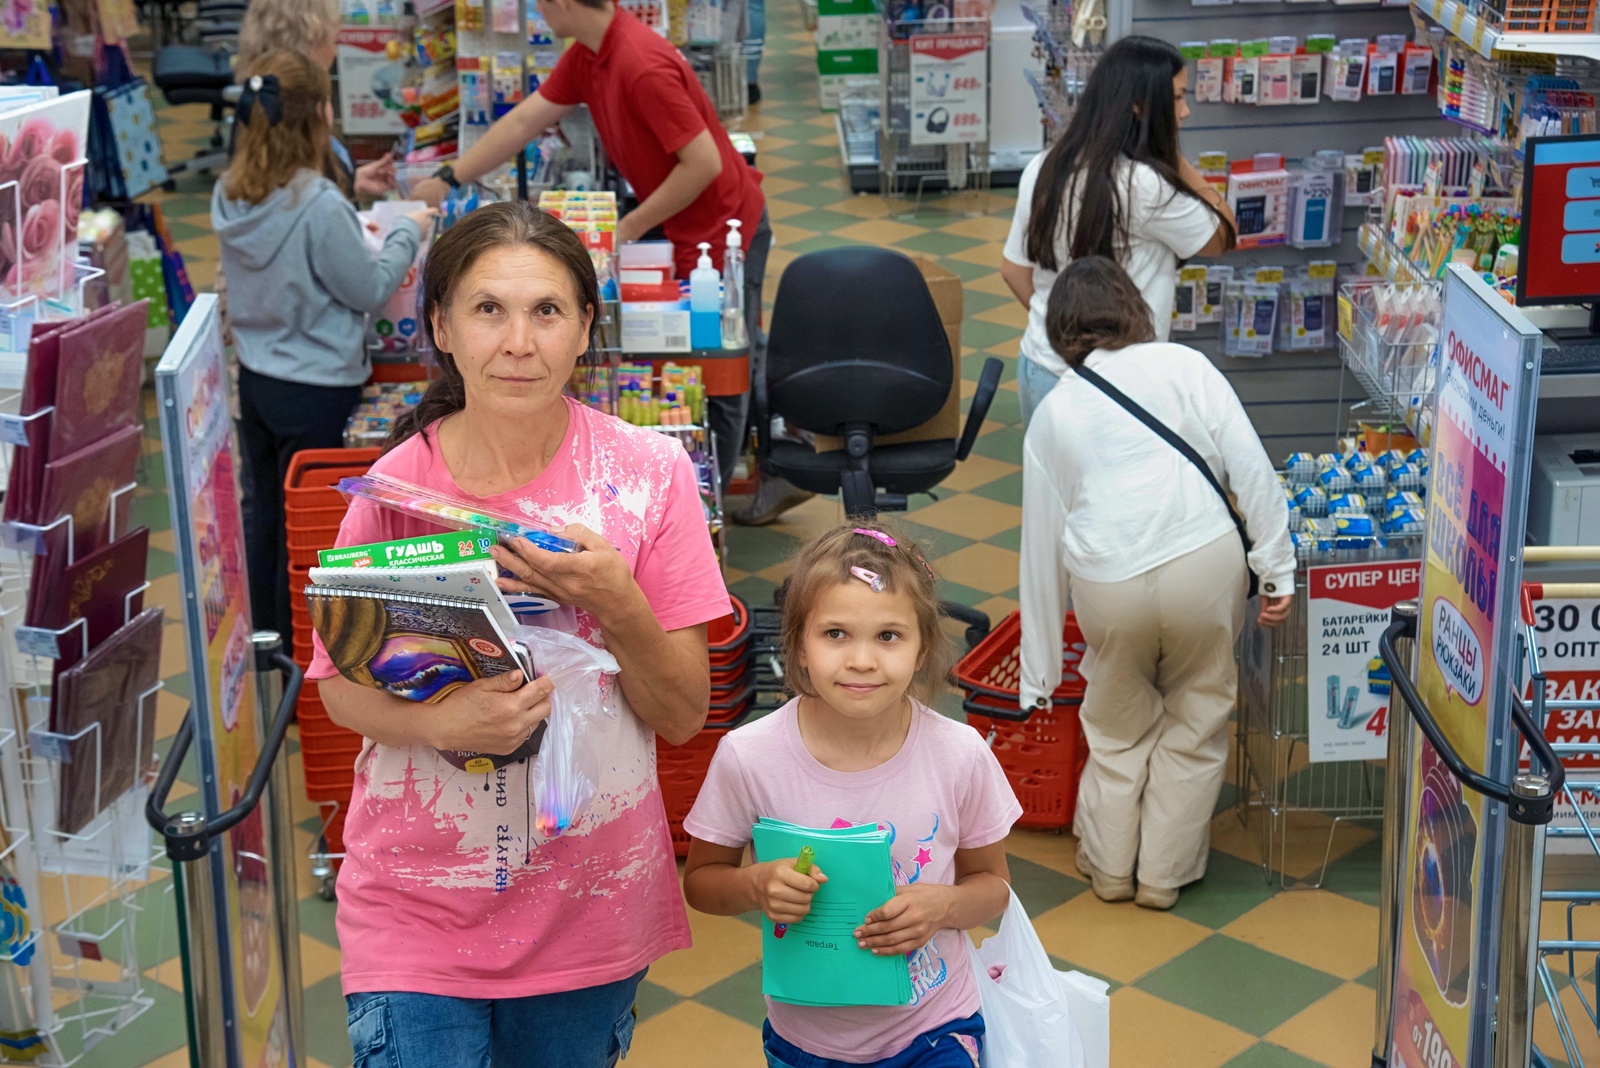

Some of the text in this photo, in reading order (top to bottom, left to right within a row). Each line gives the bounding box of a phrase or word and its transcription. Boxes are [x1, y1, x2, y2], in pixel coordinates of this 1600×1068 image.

[1448, 330, 1509, 412] ОФИСМАГ
[1478, 405, 1506, 440] деньги!
[385, 540, 444, 560] ГУАШЬ
[458, 541, 474, 551] 24
[477, 538, 491, 549] 10
[334, 550, 369, 561] BRAUBERG
[354, 558, 371, 567] kids
[388, 553, 445, 567] КЛАССИЧЕСКАЯ
[1325, 568, 1421, 590] СУПЕР ЦЕН
[1322, 612, 1389, 627] БАТАРЕЙКИ
[1438, 604, 1478, 672] РАНЦЫ
[1322, 641, 1371, 656] 24 ШТ
[1554, 641, 1600, 658] ОПТ
[1436, 634, 1476, 700] РЮКЗАКИ
[1545, 679, 1600, 701] ЗАК
[1365, 706, 1388, 737] 4
[805, 940, 839, 951] Тетрадь
